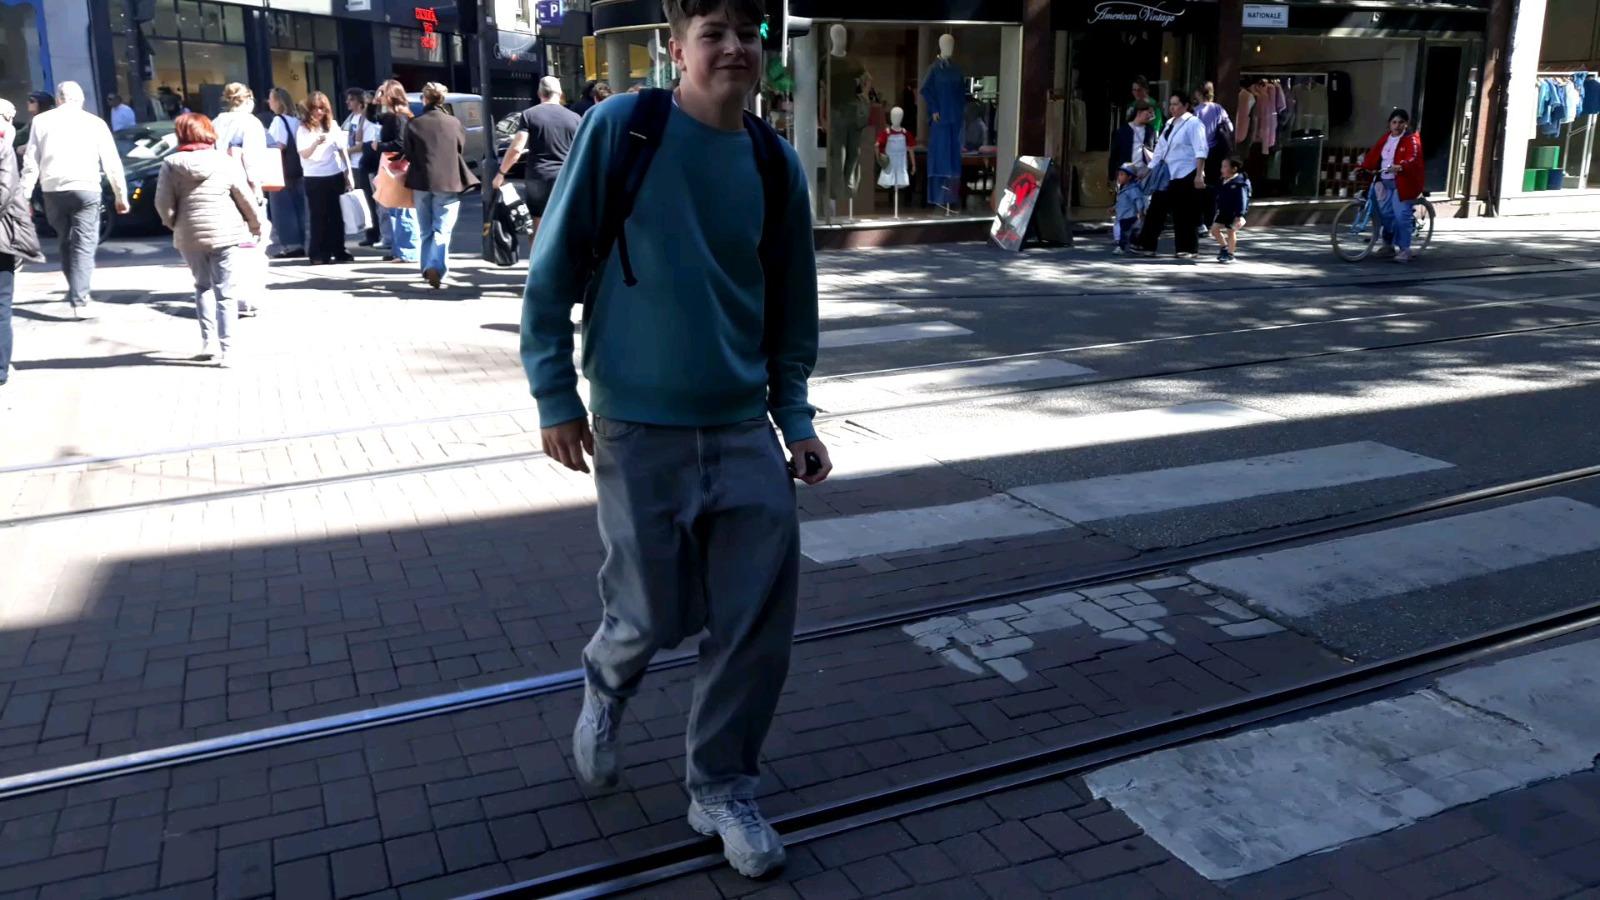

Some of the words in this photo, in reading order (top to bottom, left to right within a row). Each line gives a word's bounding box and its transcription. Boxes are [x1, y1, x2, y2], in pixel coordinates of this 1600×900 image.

[550, 4, 558, 17] P
[1088, 6, 1137, 23] American
[1139, 6, 1176, 27] Vintage
[1247, 11, 1281, 19] NATIONALE
